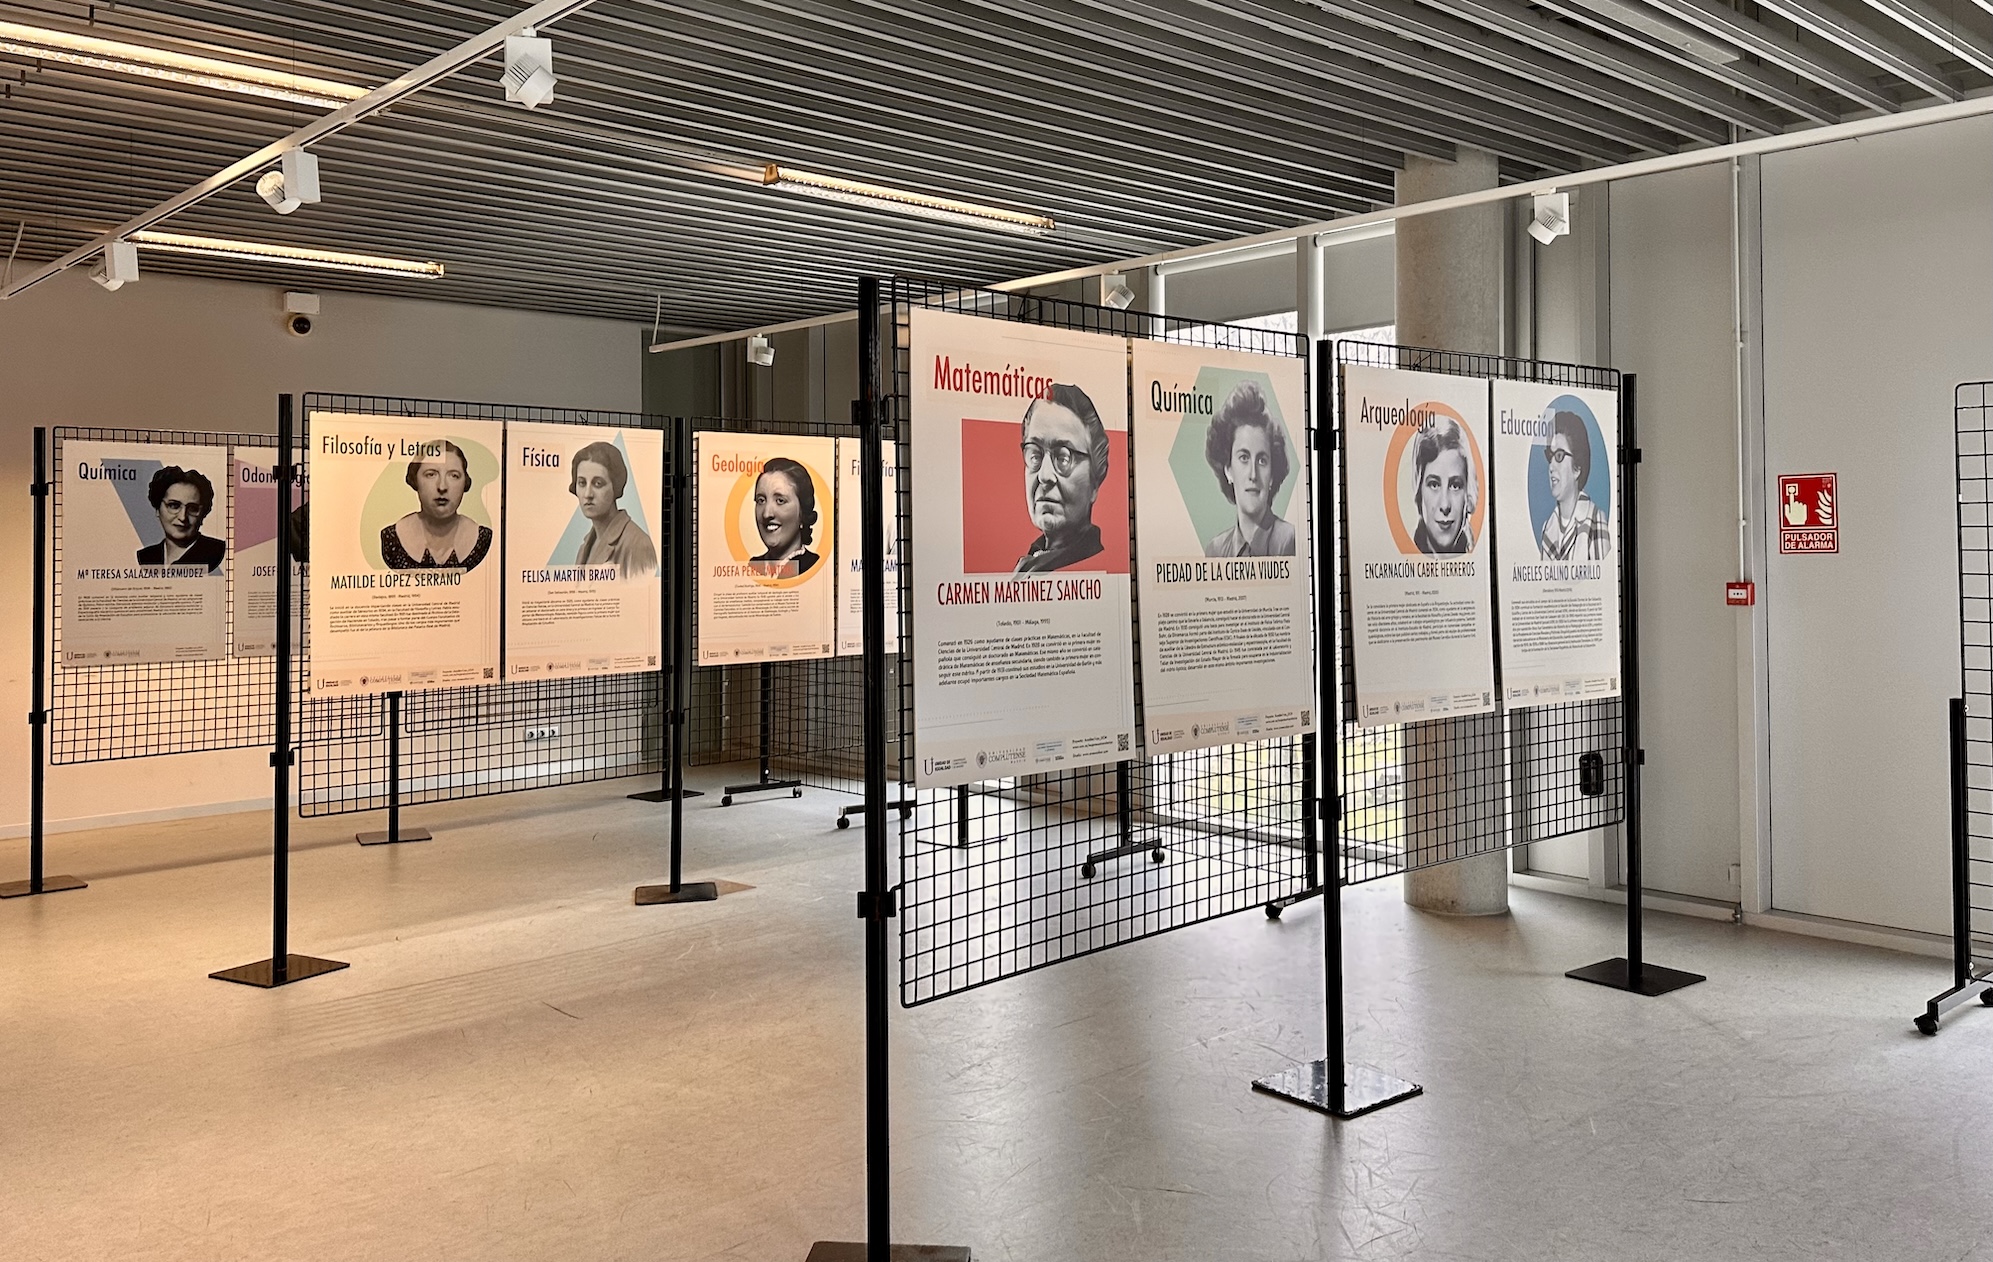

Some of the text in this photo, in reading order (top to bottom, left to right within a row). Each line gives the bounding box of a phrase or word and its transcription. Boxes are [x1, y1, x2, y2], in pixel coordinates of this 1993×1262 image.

[934, 355, 1053, 401] Matemáticas
[1151, 380, 1212, 415] Química
[1360, 396, 1435, 433] Arqueología
[1501, 409, 1554, 437] Educación
[323, 435, 441, 460] Filosofía y Letras
[523, 447, 560, 468] Física
[79, 462, 137, 482] Química
[712, 453, 764, 477] Geología
[1785, 533, 1832, 541] PULSADOR
[91, 568, 122, 580] TERESA
[124, 568, 159, 579] SALAZAR
[161, 565, 204, 578] BERMÚDEZ
[252, 566, 276, 576] JOSEF
[522, 567, 616, 583] FELISA MARTÍN BRAVO
[713, 565, 740, 577] JOSEFA
[1156, 560, 1290, 583] PIEDAD DE LA CIERVA VIUDES
[1365, 559, 1475, 579] ENCARNACIÓN CABRÉ HERREROS
[1512, 563, 1601, 582] ÁNGELES GALINO CARRILLO
[331, 571, 461, 590] MATILDE LÓPEZ SERRANO
[938, 576, 1102, 605] CARMEN MARTÍNEZ SANCHO
